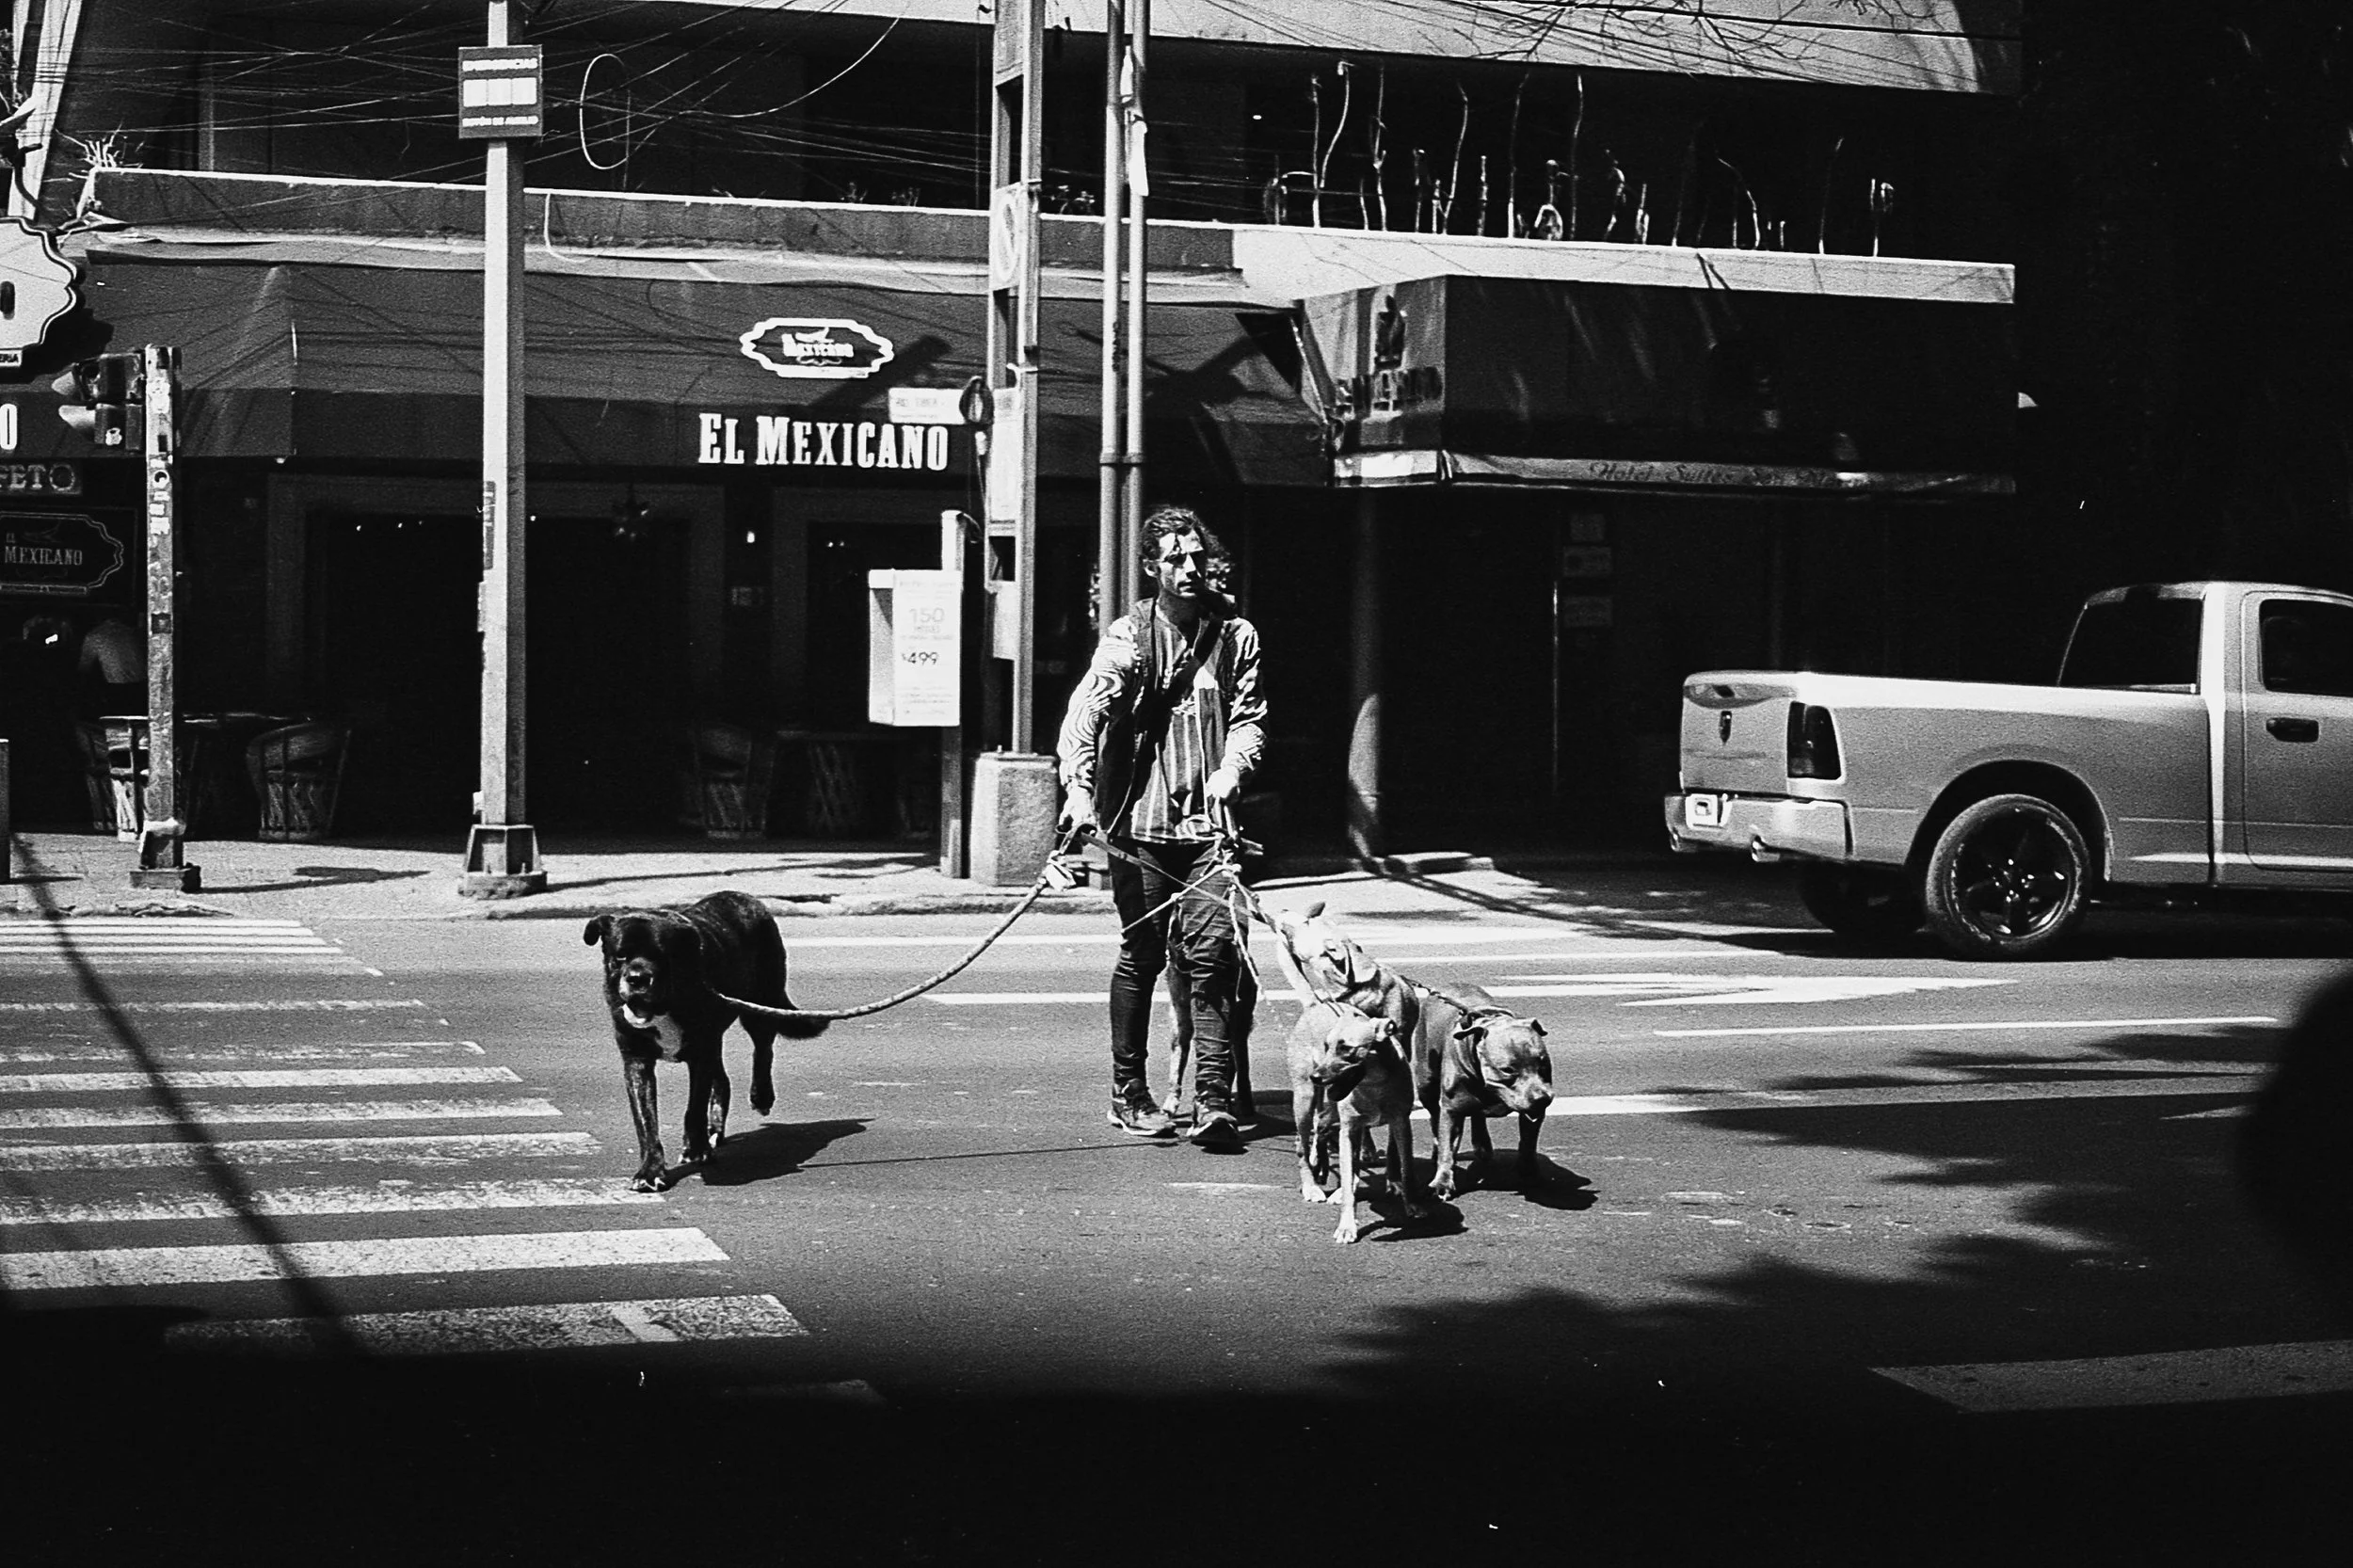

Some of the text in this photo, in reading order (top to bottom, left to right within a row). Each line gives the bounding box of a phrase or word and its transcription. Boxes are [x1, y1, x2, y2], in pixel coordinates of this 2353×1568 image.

[698, 412, 949, 471] EL MEXICANO
[5, 545, 83, 566] MEXICANO
[908, 606, 945, 624] 150
